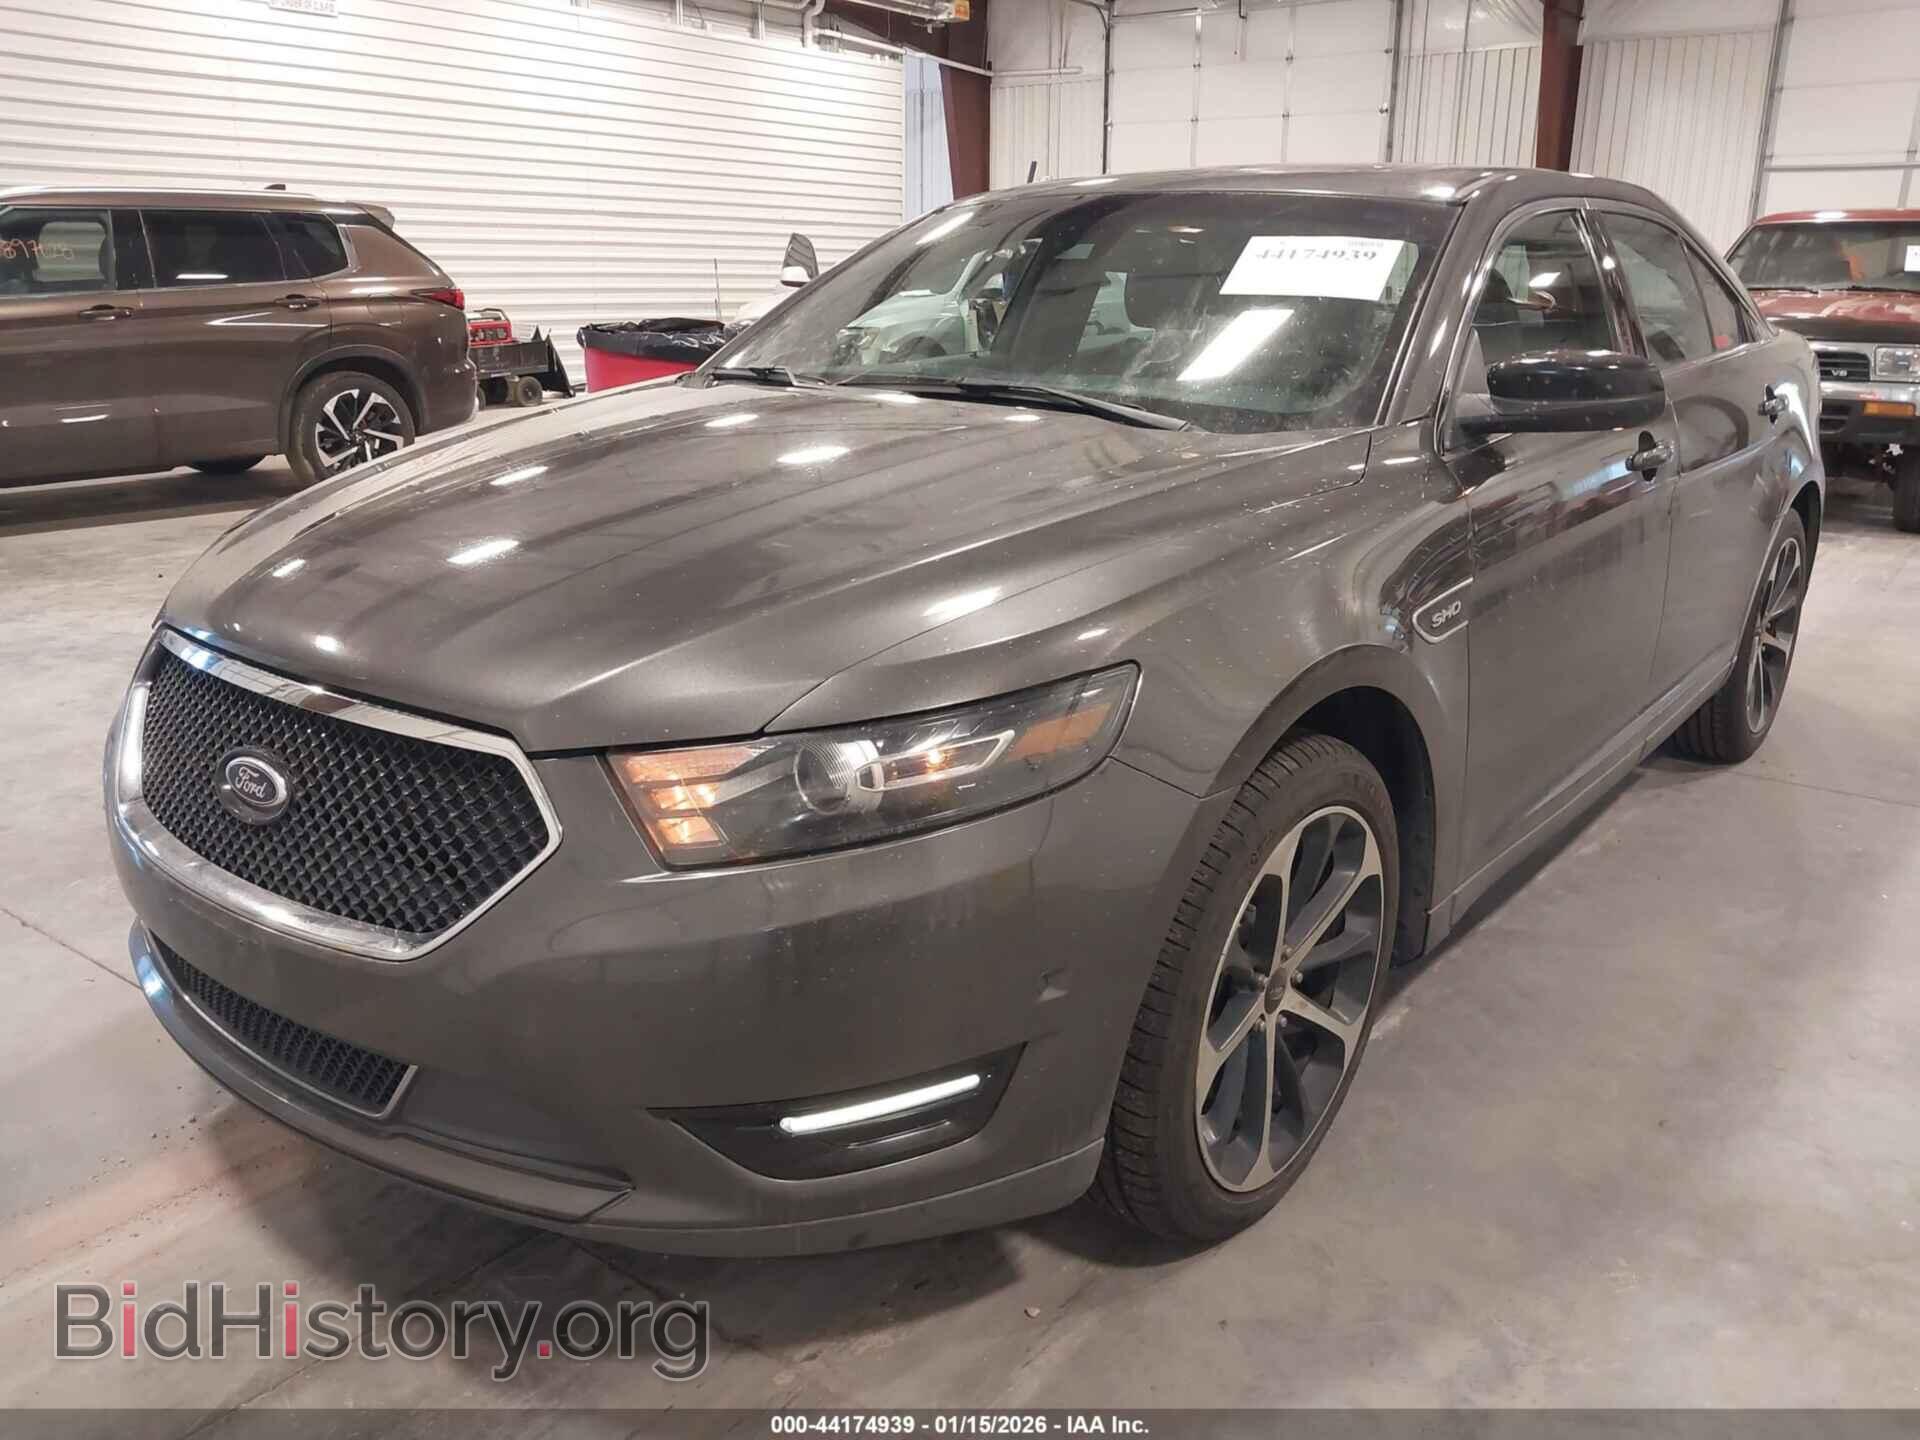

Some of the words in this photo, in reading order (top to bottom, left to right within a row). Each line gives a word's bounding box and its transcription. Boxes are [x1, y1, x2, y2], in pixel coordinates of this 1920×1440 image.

[1255, 249, 1377, 261] 44174939
[1431, 600, 1461, 628] SHO
[234, 766, 268, 798] Ford
